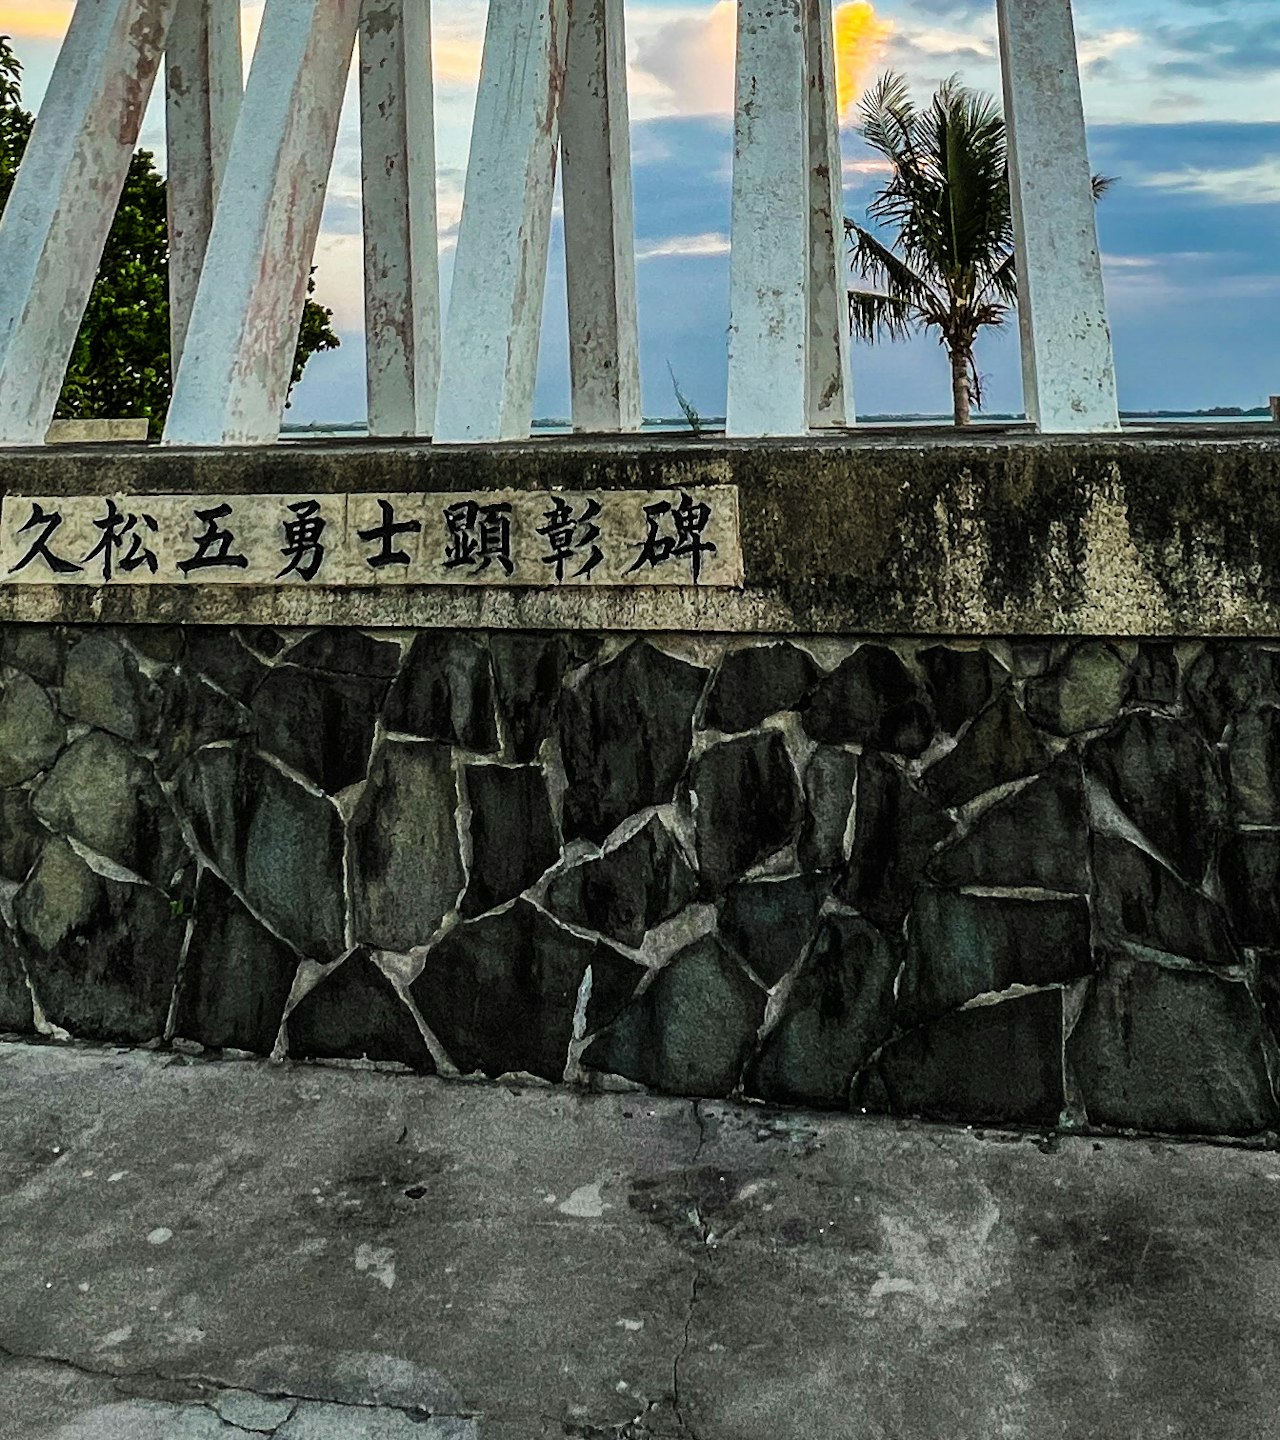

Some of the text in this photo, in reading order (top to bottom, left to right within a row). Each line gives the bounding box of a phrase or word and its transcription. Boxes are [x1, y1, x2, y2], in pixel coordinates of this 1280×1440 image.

[8, 492, 716, 583] 久松五勇士顕彰碑
